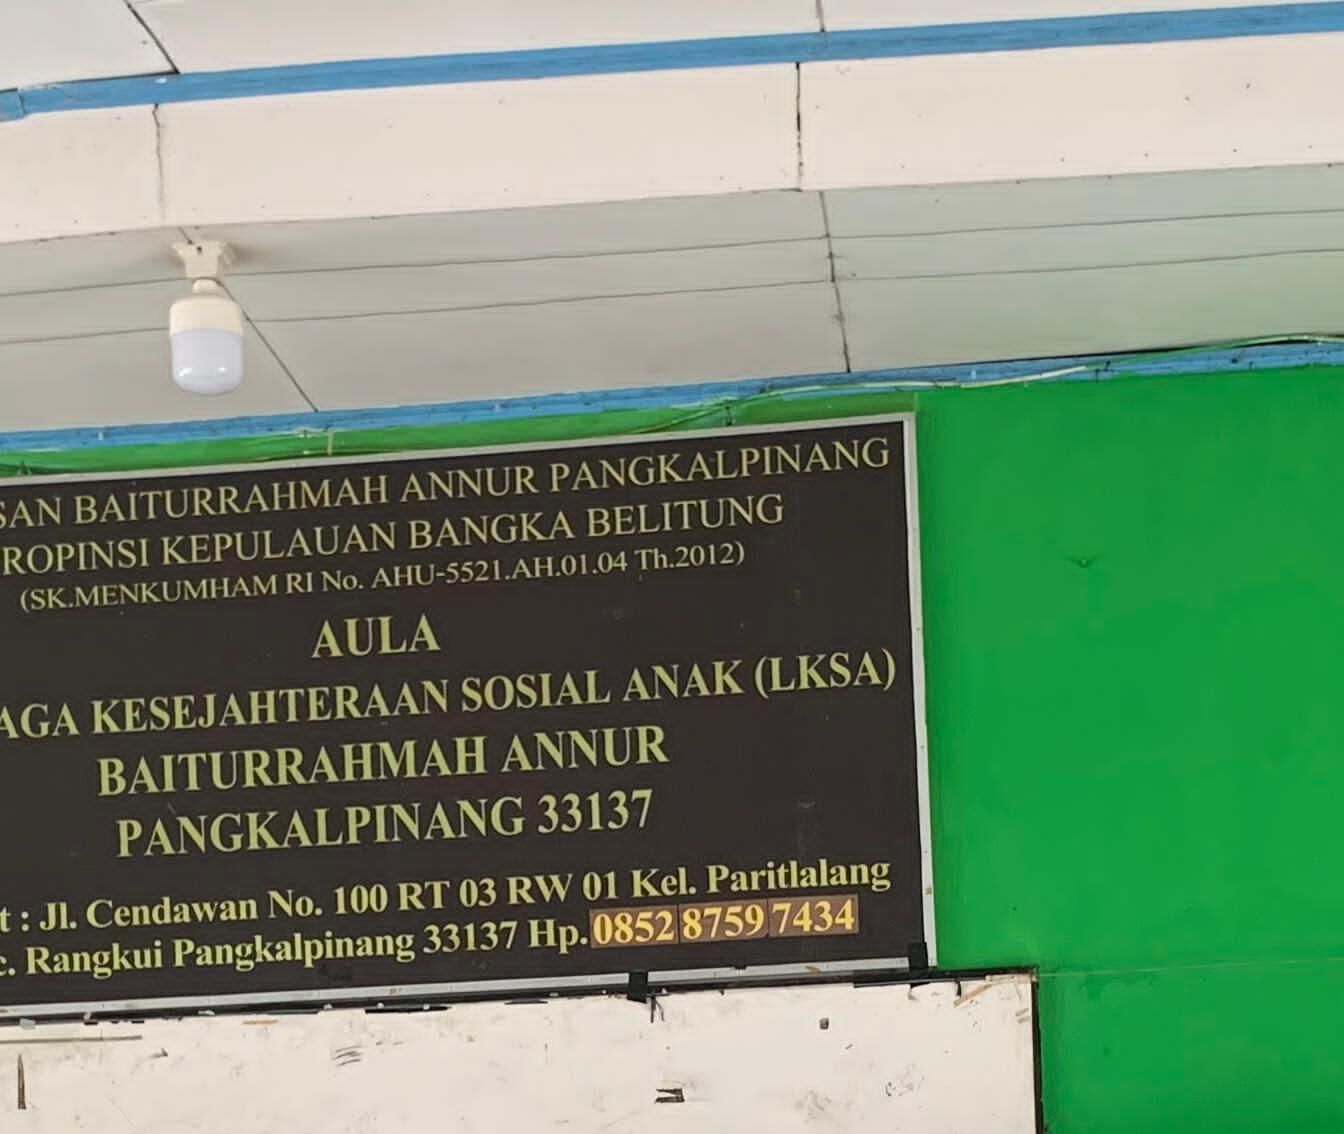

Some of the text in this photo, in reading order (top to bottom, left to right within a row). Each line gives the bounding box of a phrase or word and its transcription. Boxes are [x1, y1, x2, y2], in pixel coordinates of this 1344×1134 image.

[76, 476, 386, 523] BAITURRAHMAH
[401, 466, 538, 501] ANNUR
[551, 438, 888, 491] PANGKALPINANG
[162, 522, 394, 564] KEPULAUAN
[410, 512, 574, 548] BANGKA
[588, 495, 782, 536] BELITUNG
[21, 542, 744, 611] (SK.MENKUMHAM RI No. AHU-5521.AH.01.04 Th.2012)
[312, 615, 440, 657] AULA
[92, 680, 447, 733] KESEJAHTERAAN
[462, 671, 610, 711] SOSIAL
[624, 660, 743, 701] ANAK
[756, 648, 895, 698] (LKSA)
[98, 726, 669, 795] BAITURRAHMAH ANNUR
[118, 789, 652, 856] PANGKALPINANG 33137
[21, 912, 29, 931] :
[40, 902, 77, 930] Jl.
[87, 896, 258, 928] Cendawan
[268, 890, 322, 918] No.
[336, 884, 387, 914] 100
[398, 881, 450, 910] RT
[460, 878, 496, 907] 03
[508, 874, 572, 904] RW
[583, 872, 616, 900] 01
[632, 867, 696, 897] Kel.
[708, 859, 890, 892] Paritlalang
[27, 940, 162, 979] Rangkui
[174, 931, 415, 971] Pangkalpinang
[424, 921, 517, 953] 33137
[529, 919, 587, 953] Hp.
[591, 911, 676, 945] 0852
[682, 904, 765, 940] 8759
[772, 898, 855, 933] 7434
